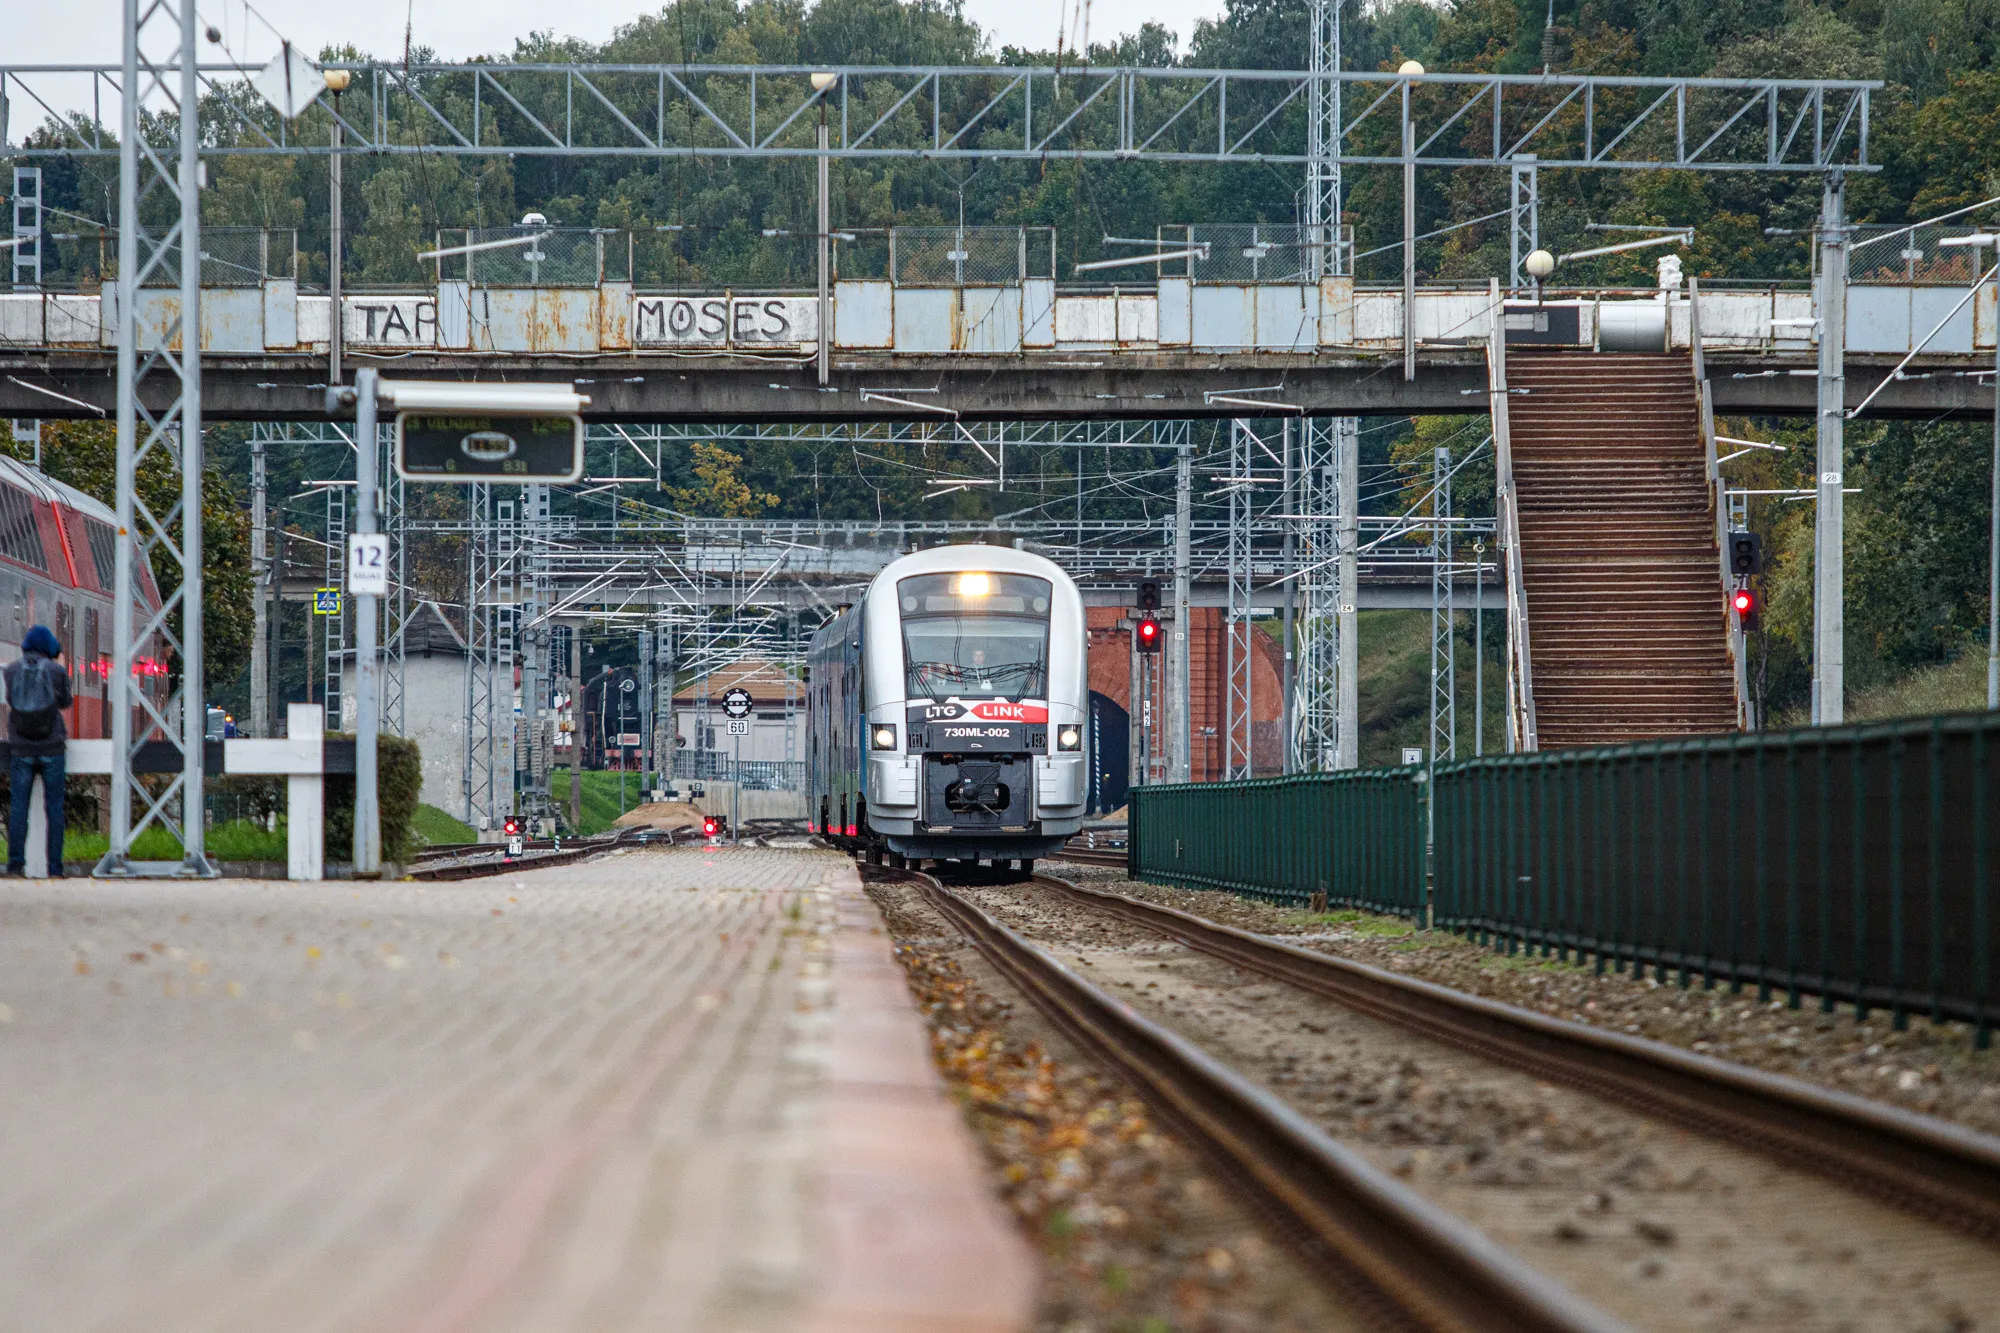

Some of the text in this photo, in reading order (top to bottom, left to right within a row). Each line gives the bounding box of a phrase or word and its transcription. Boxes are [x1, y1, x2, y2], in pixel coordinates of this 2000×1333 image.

[636, 301, 790, 340] MOSES
[1826, 473, 1837, 482] 28
[354, 545, 381, 566] 12
[926, 705, 1025, 718] LTG LINK
[731, 722, 745, 733] 60
[944, 728, 1010, 738] 730ML-002
